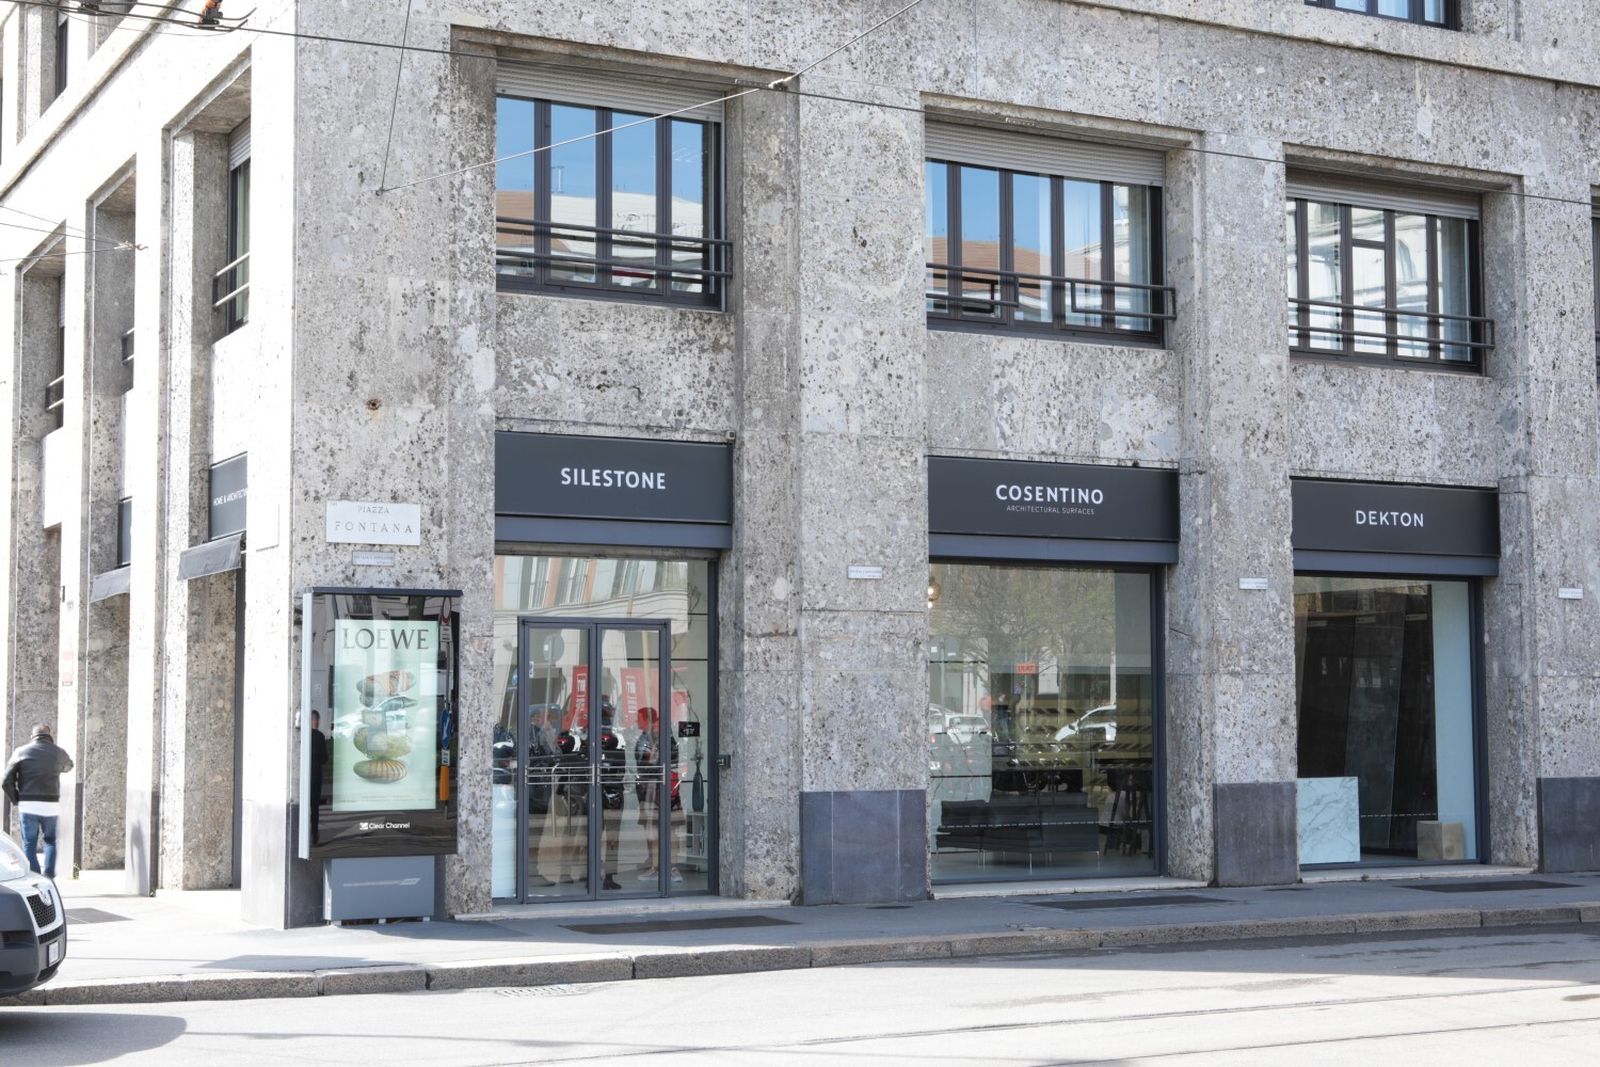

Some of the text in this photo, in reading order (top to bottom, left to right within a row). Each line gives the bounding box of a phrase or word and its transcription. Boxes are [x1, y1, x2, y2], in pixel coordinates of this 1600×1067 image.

[560, 467, 666, 490] SILESTONE
[995, 484, 1104, 505] COSENTINO
[358, 505, 390, 514] PIAZZA
[1006, 505, 1095, 515] ARCHITECTURAL SURFACES
[1355, 510, 1424, 527] DEKTON
[335, 521, 413, 534] FONTANA
[343, 628, 430, 650] LOEWE
[385, 822, 411, 830] Channel
